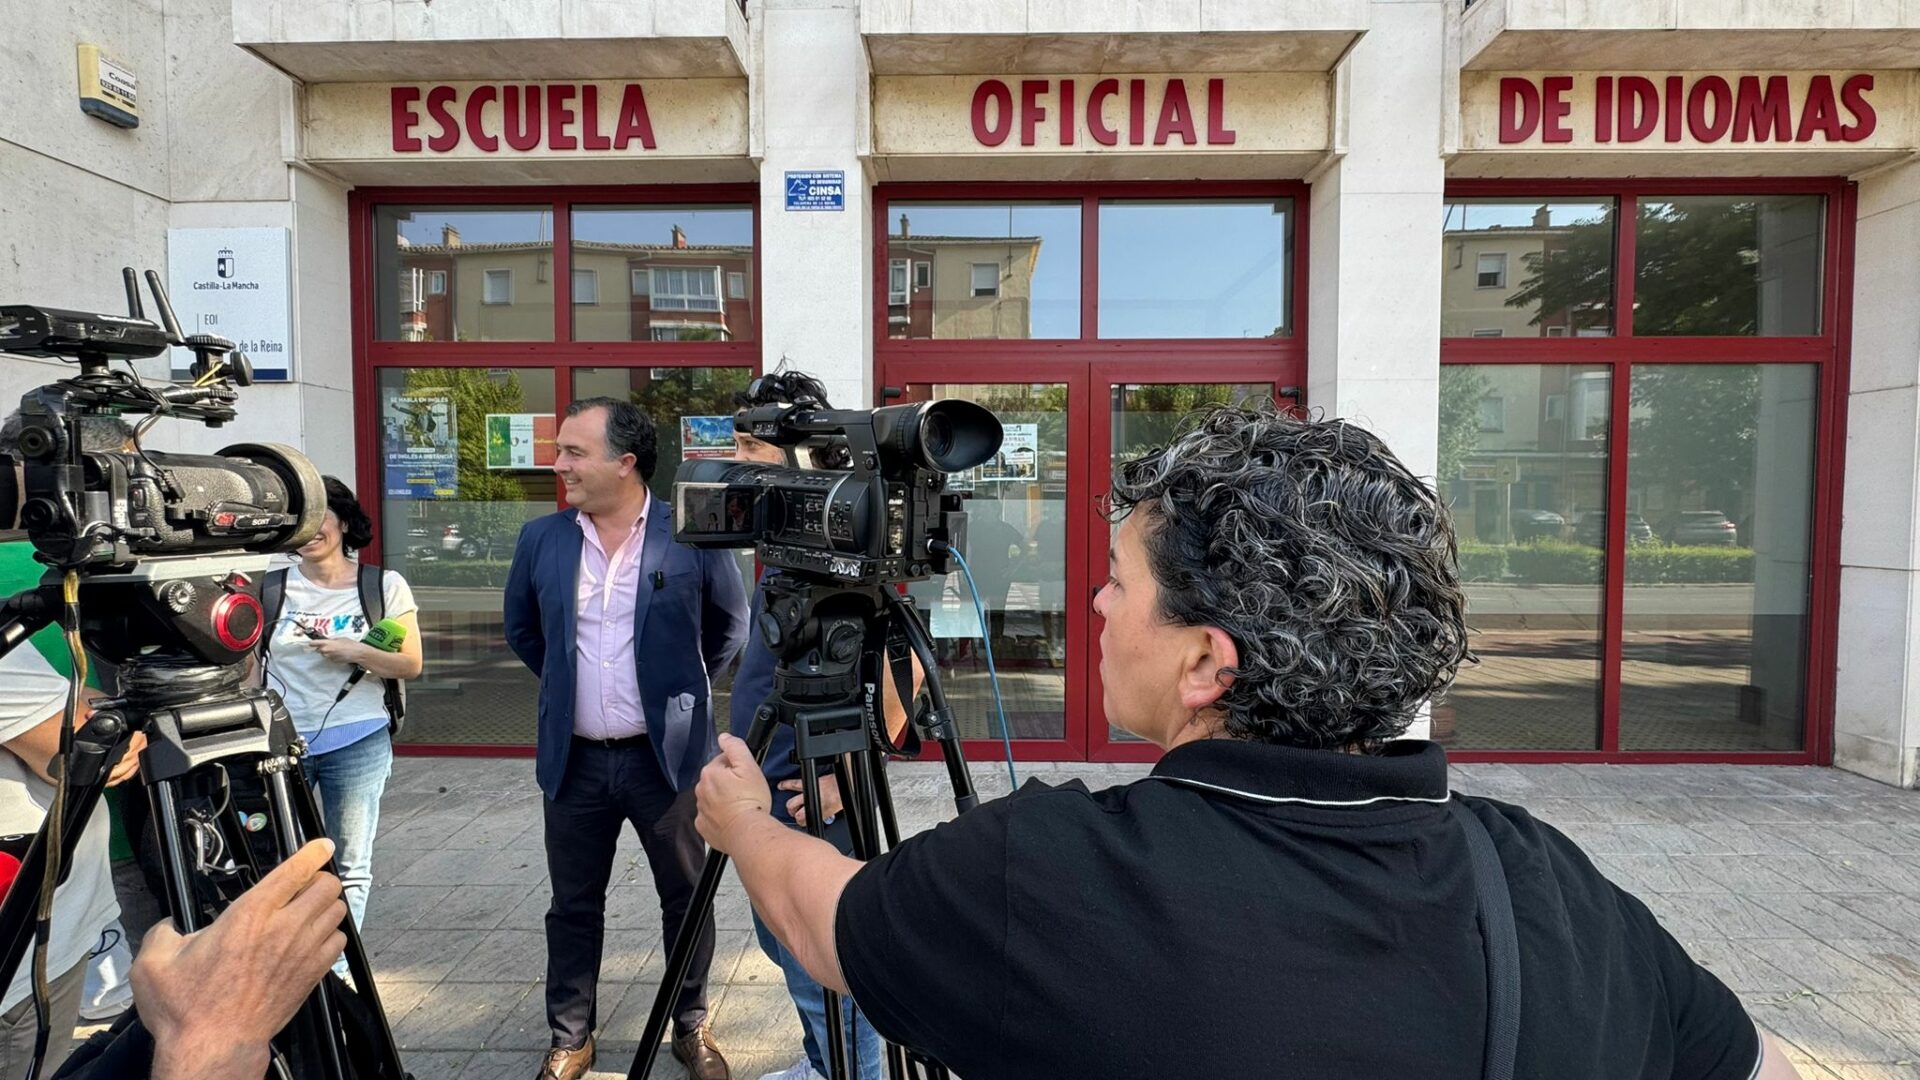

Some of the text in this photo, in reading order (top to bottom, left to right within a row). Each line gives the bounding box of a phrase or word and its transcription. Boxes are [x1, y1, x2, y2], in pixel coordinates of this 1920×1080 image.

[971, 78, 1236, 146] OFICIAL
[1499, 74, 1877, 143] DE IDIOMAS
[391, 84, 657, 152] ESCUELA
[809, 186, 841, 196] CINSA
[193, 281, 259, 290] Castilla-La Mancha
[204, 314, 218, 325] EOI
[239, 340, 283, 352] de la Reina
[252, 518, 270, 526] SONY
[864, 682, 886, 750] Panason
